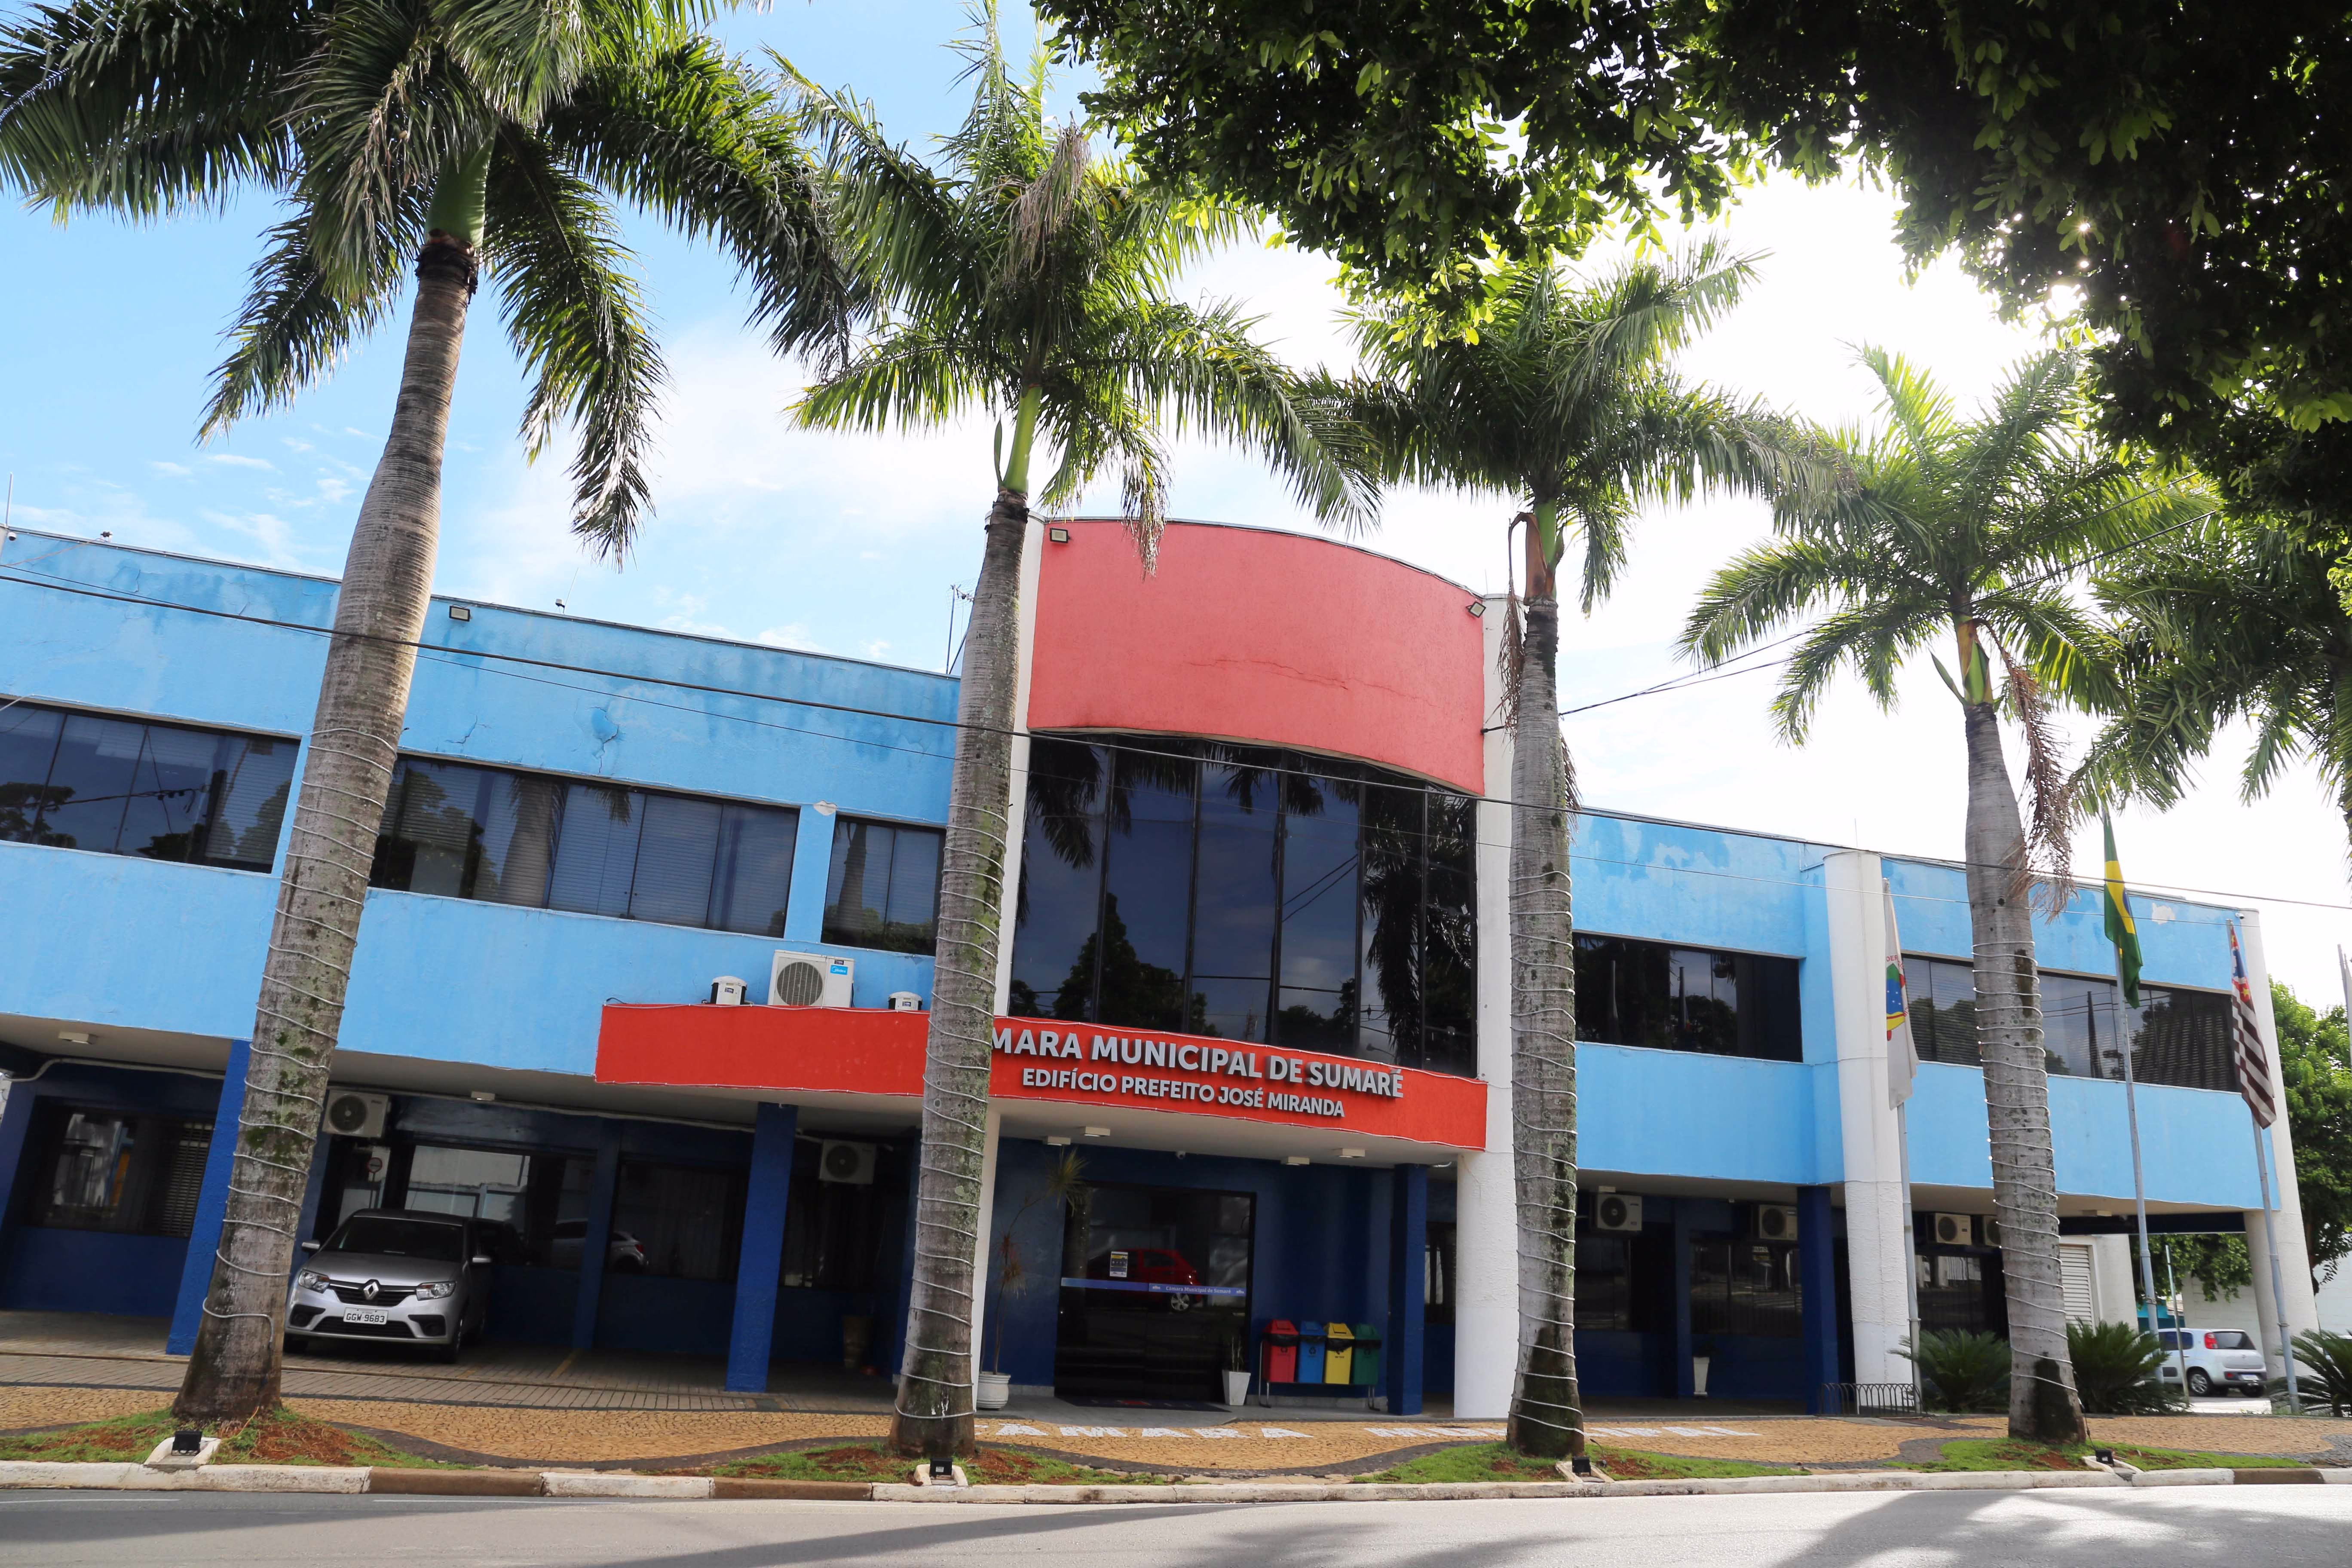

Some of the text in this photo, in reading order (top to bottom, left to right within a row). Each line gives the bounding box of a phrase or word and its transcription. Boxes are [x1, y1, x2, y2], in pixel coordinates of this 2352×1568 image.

[1023, 1068, 1345, 1118] EDIFÍCIO PREFEITO JOSÉ MIRANDA
[1091, 1035, 1262, 1078] MUNICIPAL
[1269, 1055, 1303, 1083] DE
[1309, 1061, 1403, 1098] SUMARÉ
